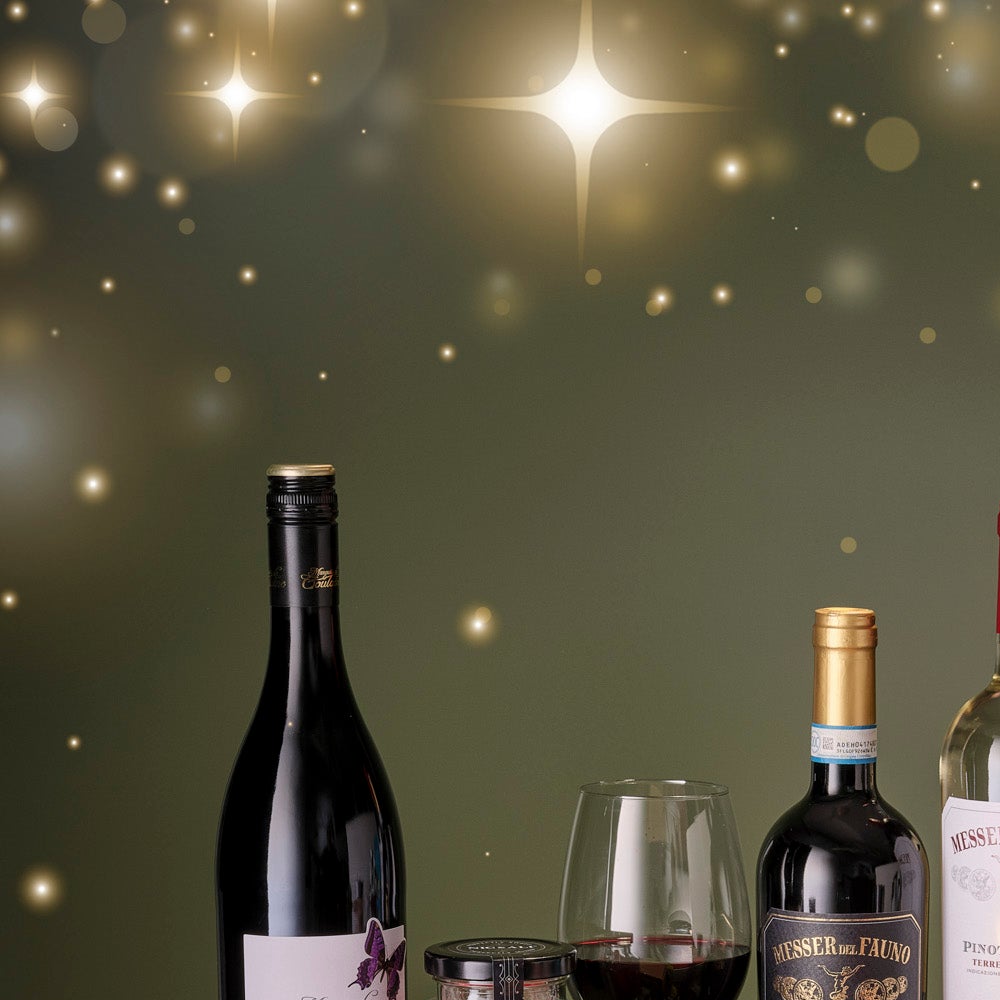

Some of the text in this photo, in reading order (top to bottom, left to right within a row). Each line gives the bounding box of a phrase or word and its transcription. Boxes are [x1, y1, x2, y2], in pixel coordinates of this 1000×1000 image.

[773, 936, 911, 966] MESSER DEL FAUNO
[972, 959, 1000, 969] TERRE
